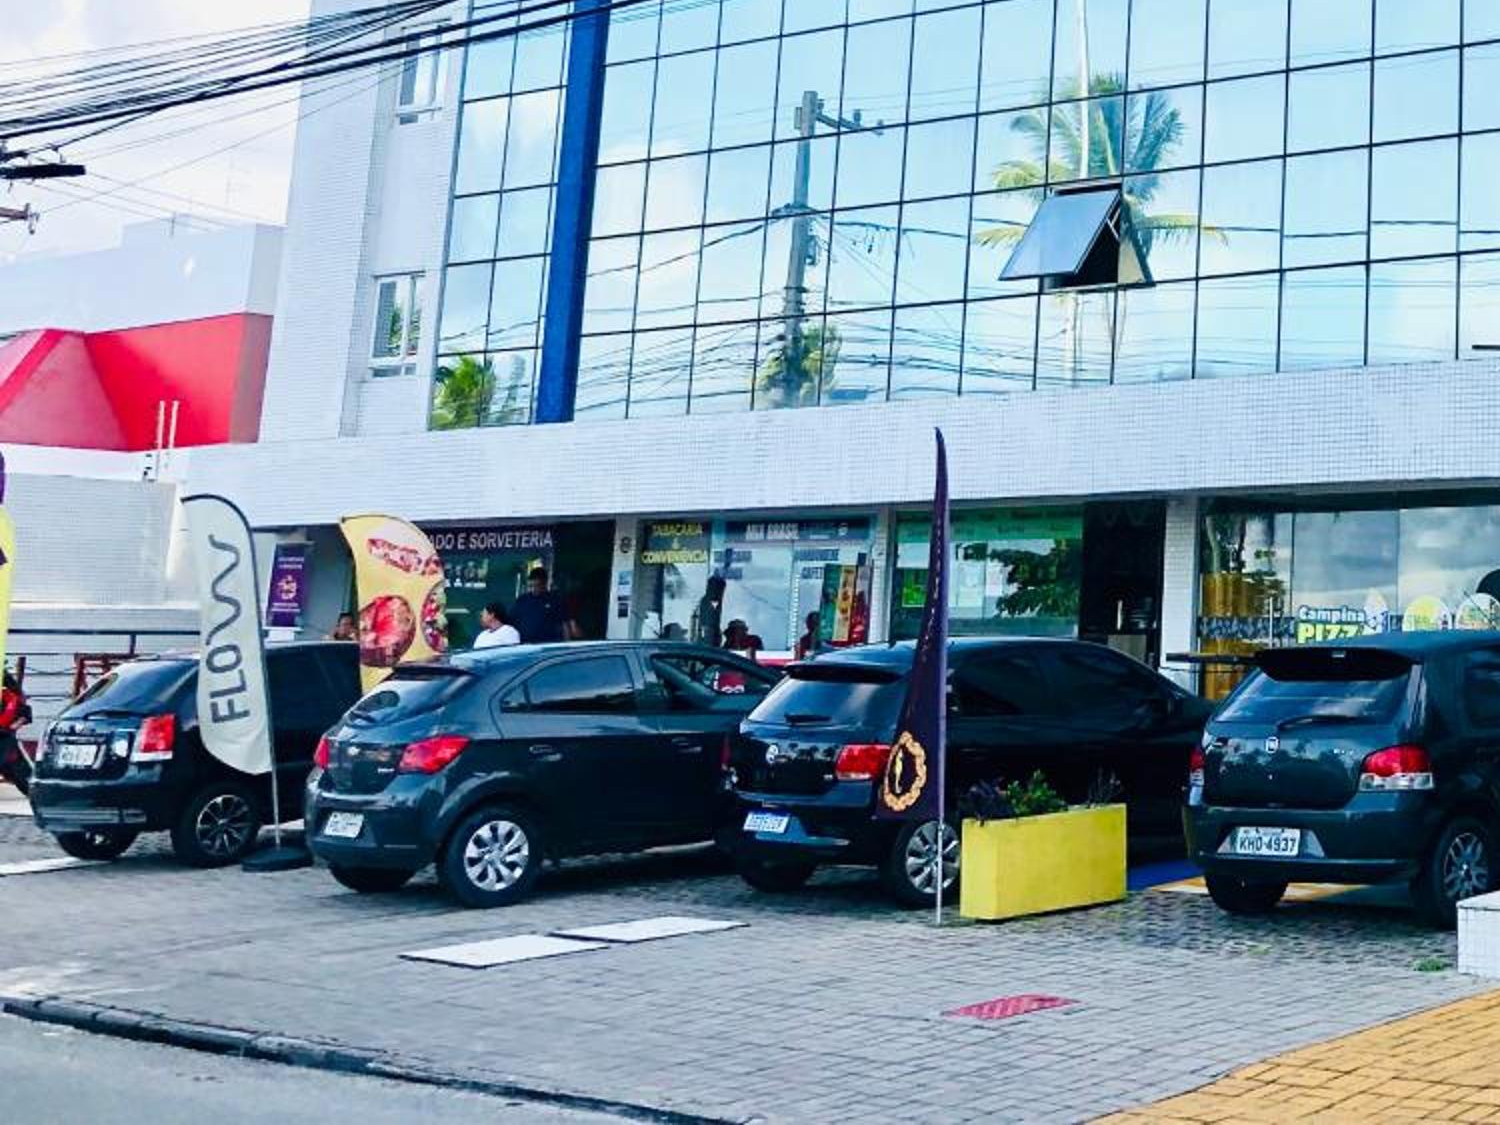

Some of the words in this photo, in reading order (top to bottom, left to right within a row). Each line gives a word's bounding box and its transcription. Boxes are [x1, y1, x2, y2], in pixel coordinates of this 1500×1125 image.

[457, 533, 466, 549] E
[468, 531, 553, 549] SORVETERIA
[204, 533, 251, 724] FLOW
